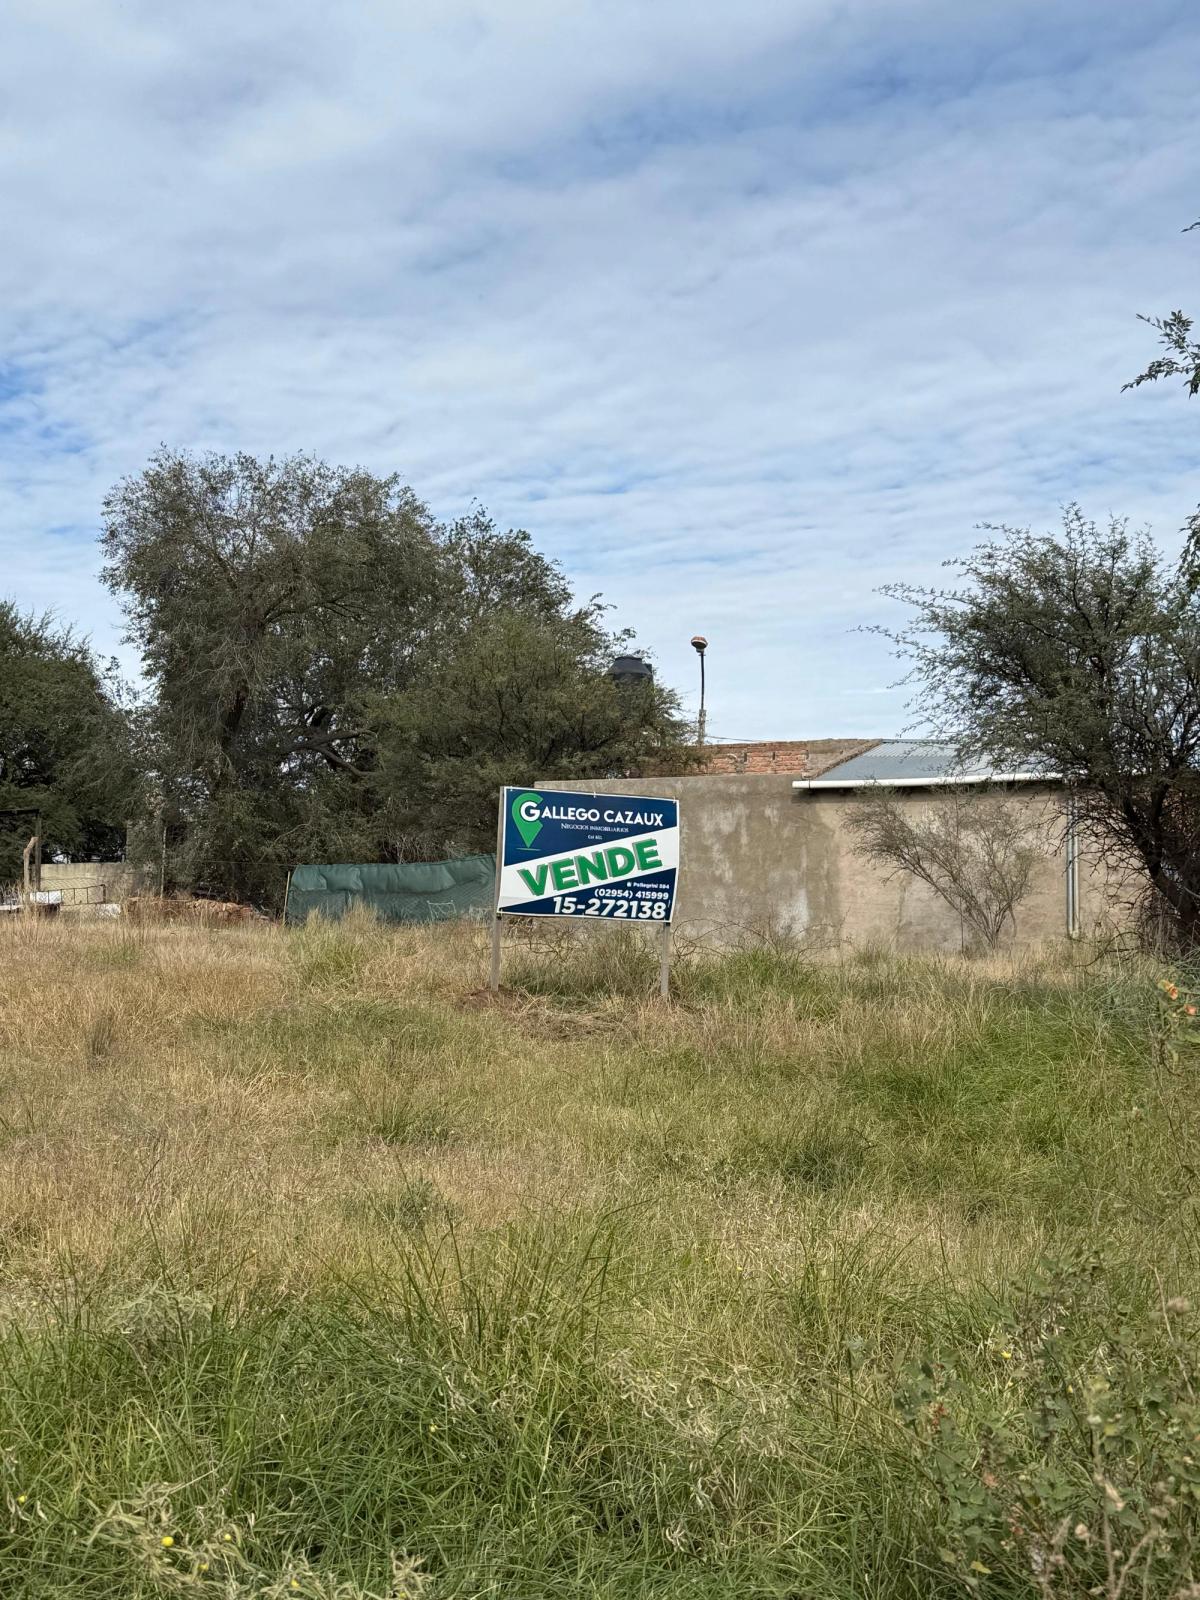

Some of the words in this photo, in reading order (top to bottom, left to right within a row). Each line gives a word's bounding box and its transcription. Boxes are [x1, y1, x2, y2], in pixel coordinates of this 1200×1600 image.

[520, 801, 600, 821] GALLEGO
[604, 809, 663, 826] CAZAUX
[517, 838, 663, 896] VENDE
[594, 888, 633, 899] (02954)
[635, 890, 669, 900] 415999
[553, 896, 667, 919] 15-272138
